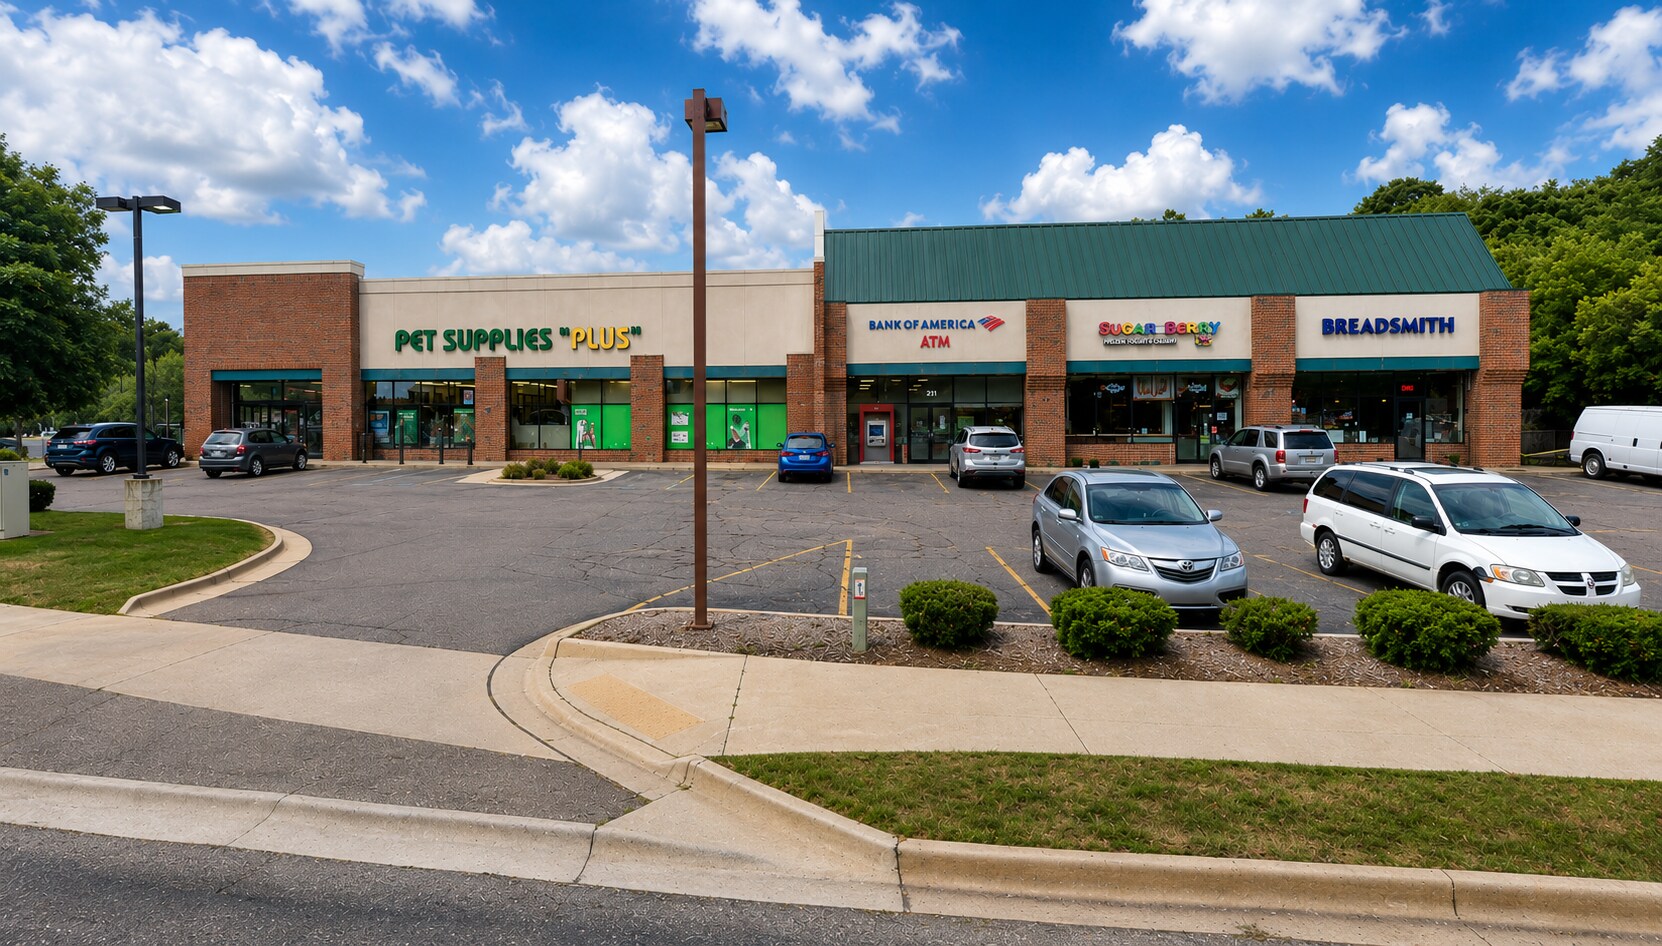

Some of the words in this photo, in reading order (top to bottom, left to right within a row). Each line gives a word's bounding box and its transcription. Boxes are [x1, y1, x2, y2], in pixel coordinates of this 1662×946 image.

[869, 320, 901, 330] BANK
[903, 319, 919, 330] OF
[920, 319, 976, 330] AMERICA
[1099, 321, 1156, 336] SUGAR
[1164, 321, 1221, 336] BERRY
[1322, 316, 1455, 335] BREADSMITH
[394, 329, 438, 352] PET
[443, 327, 553, 352] SUPPLIES
[559, 325, 642, 350] "PLUS"
[920, 335, 951, 348] ATM
